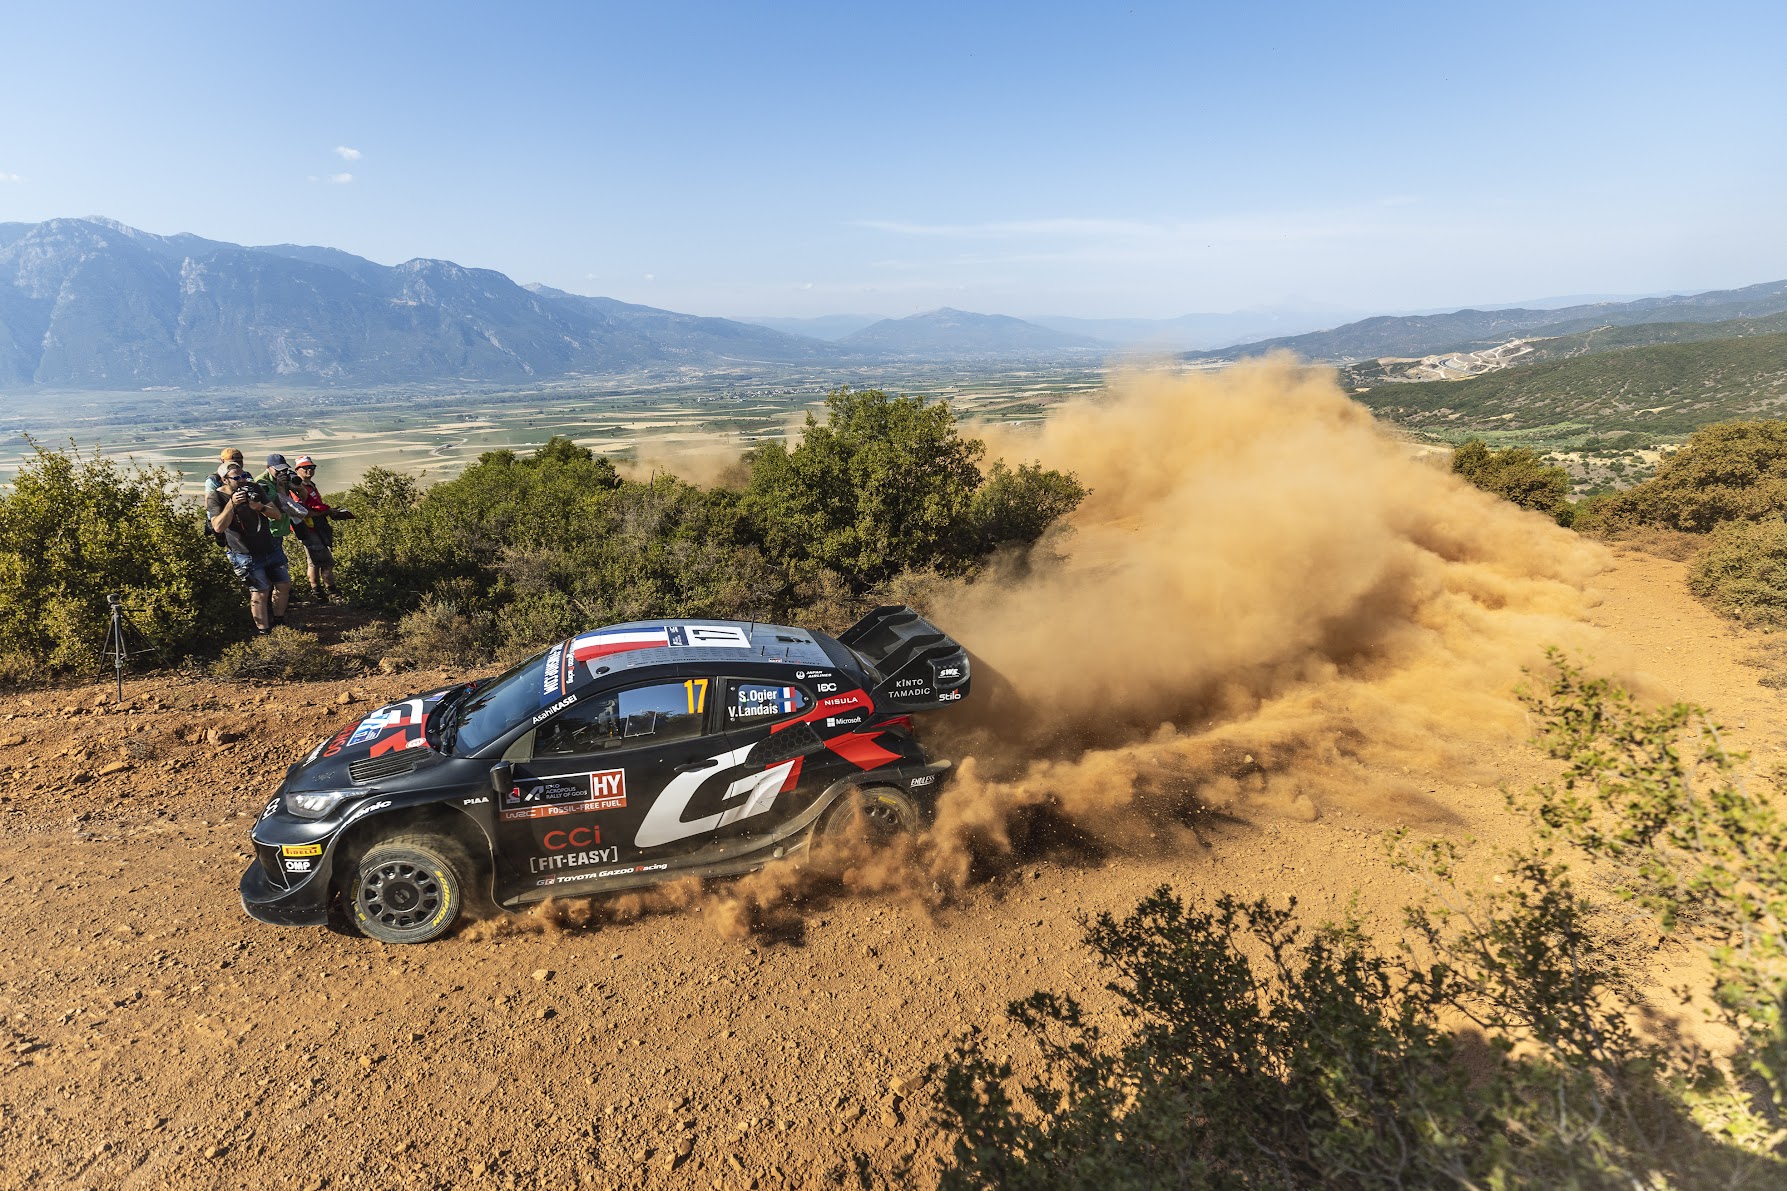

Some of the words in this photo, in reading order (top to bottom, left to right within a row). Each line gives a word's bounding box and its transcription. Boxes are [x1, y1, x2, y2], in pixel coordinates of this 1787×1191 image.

[684, 679, 708, 714] 17
[738, 689, 778, 703] S.Ogier
[824, 696, 859, 706] NISULA
[939, 689, 962, 701] Stilo
[728, 703, 779, 718] V.Landais
[836, 716, 862, 726] Microsoft
[593, 774, 622, 797] HY
[910, 775, 936, 787] ENDLESS
[545, 786, 576, 795] ACROPOLIS
[571, 789, 588, 797] GODS
[463, 796, 490, 806] PIAA
[505, 809, 536, 819] WRC
[548, 801, 600, 815] FOSSIL-FREE
[602, 799, 622, 809] FUEL
[284, 846, 318, 855] PIRELLI
[285, 860, 311, 871] OMP
[557, 872, 598, 883] TOYOTA
[599, 868, 634, 878] GAZOO
[635, 863, 668, 873] Racing
